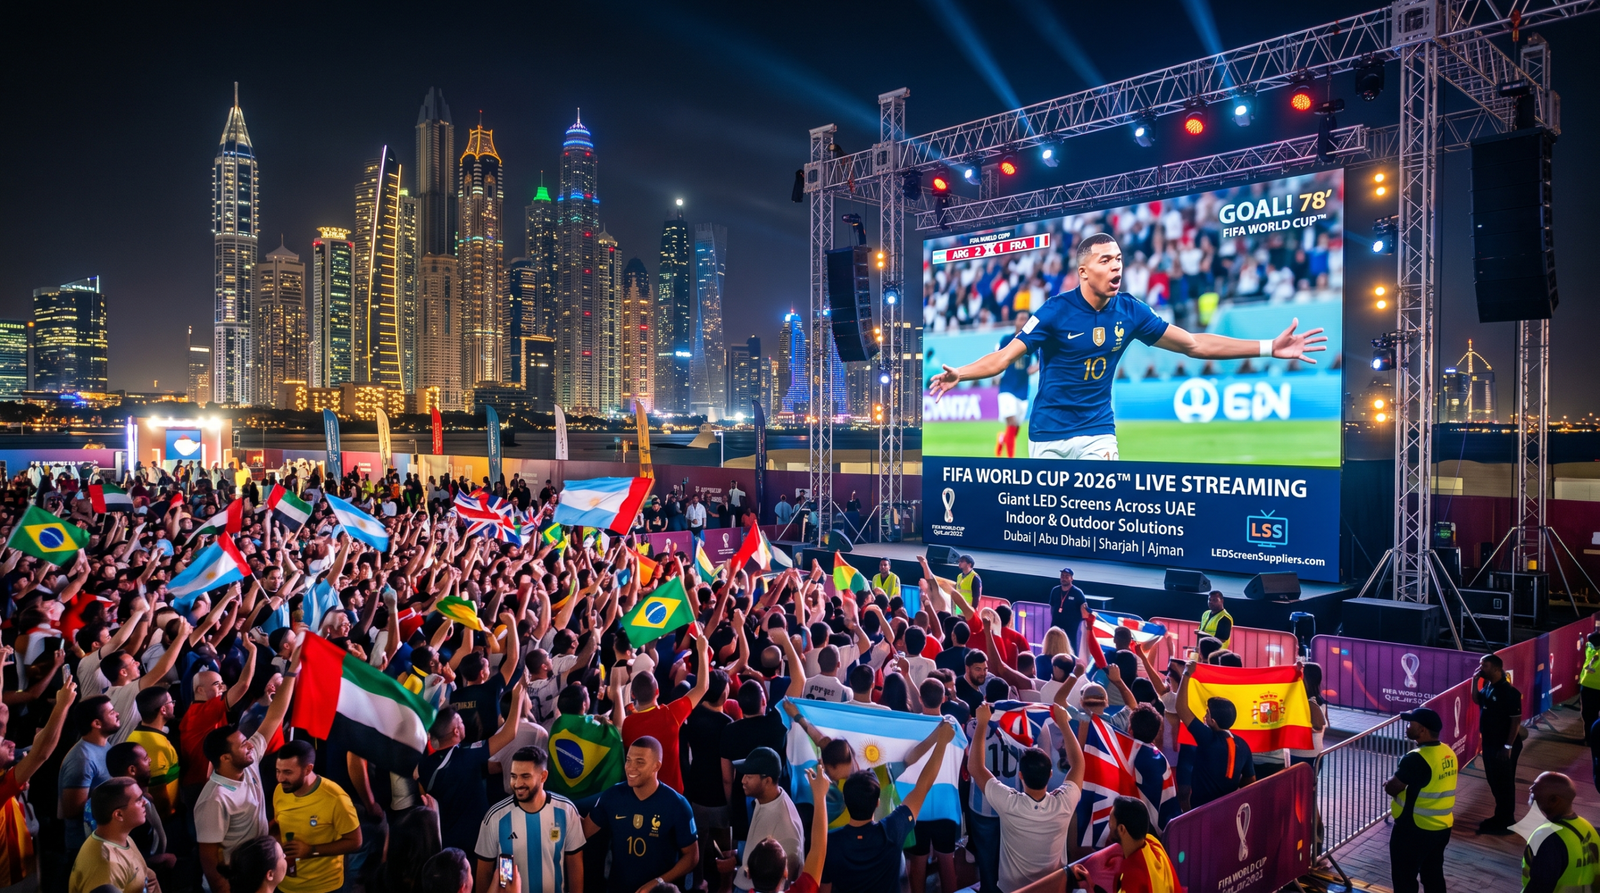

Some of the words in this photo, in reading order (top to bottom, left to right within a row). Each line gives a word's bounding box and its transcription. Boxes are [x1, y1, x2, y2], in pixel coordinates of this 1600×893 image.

[1219, 194, 1293, 224] GOAL!
[1223, 225, 1246, 238] FIFA
[1248, 219, 1291, 235] WORLD
[952, 249, 969, 259] ARG
[974, 247, 982, 256] 2
[998, 243, 1003, 252] 1
[1010, 240, 1027, 250] FRA
[1084, 356, 1107, 381] 10
[943, 467, 973, 483] FIFA
[976, 467, 1033, 486] WORLD
[1036, 470, 1070, 487] CUP
[1135, 474, 1176, 492] LIVE
[1181, 475, 1307, 498] STREAMING
[998, 492, 1030, 507] Giant
[1033, 494, 1057, 508] LED
[1060, 495, 1111, 512] Screens
[1115, 498, 1161, 514] Across
[1165, 501, 1196, 517] UAE
[1005, 510, 1045, 526] Indoor
[1048, 513, 1057, 527] &
[1060, 513, 1115, 531] Outdoor
[1118, 518, 1184, 537] Solutions
[1251, 522, 1283, 539] LSS
[1003, 529, 1031, 543] Dubai
[1038, 532, 1058, 546] Abu
[1060, 534, 1091, 548] Dhabi
[1099, 537, 1138, 554] Sharjah
[1147, 541, 1184, 558] Ajman
[1211, 548, 1326, 567] LEDScreenSuppliers.com
[1398, 690, 1423, 698] WORLD
[626, 836, 647, 857] 10
[1218, 875, 1232, 890] FIFA
[1232, 863, 1255, 882] WORLD
